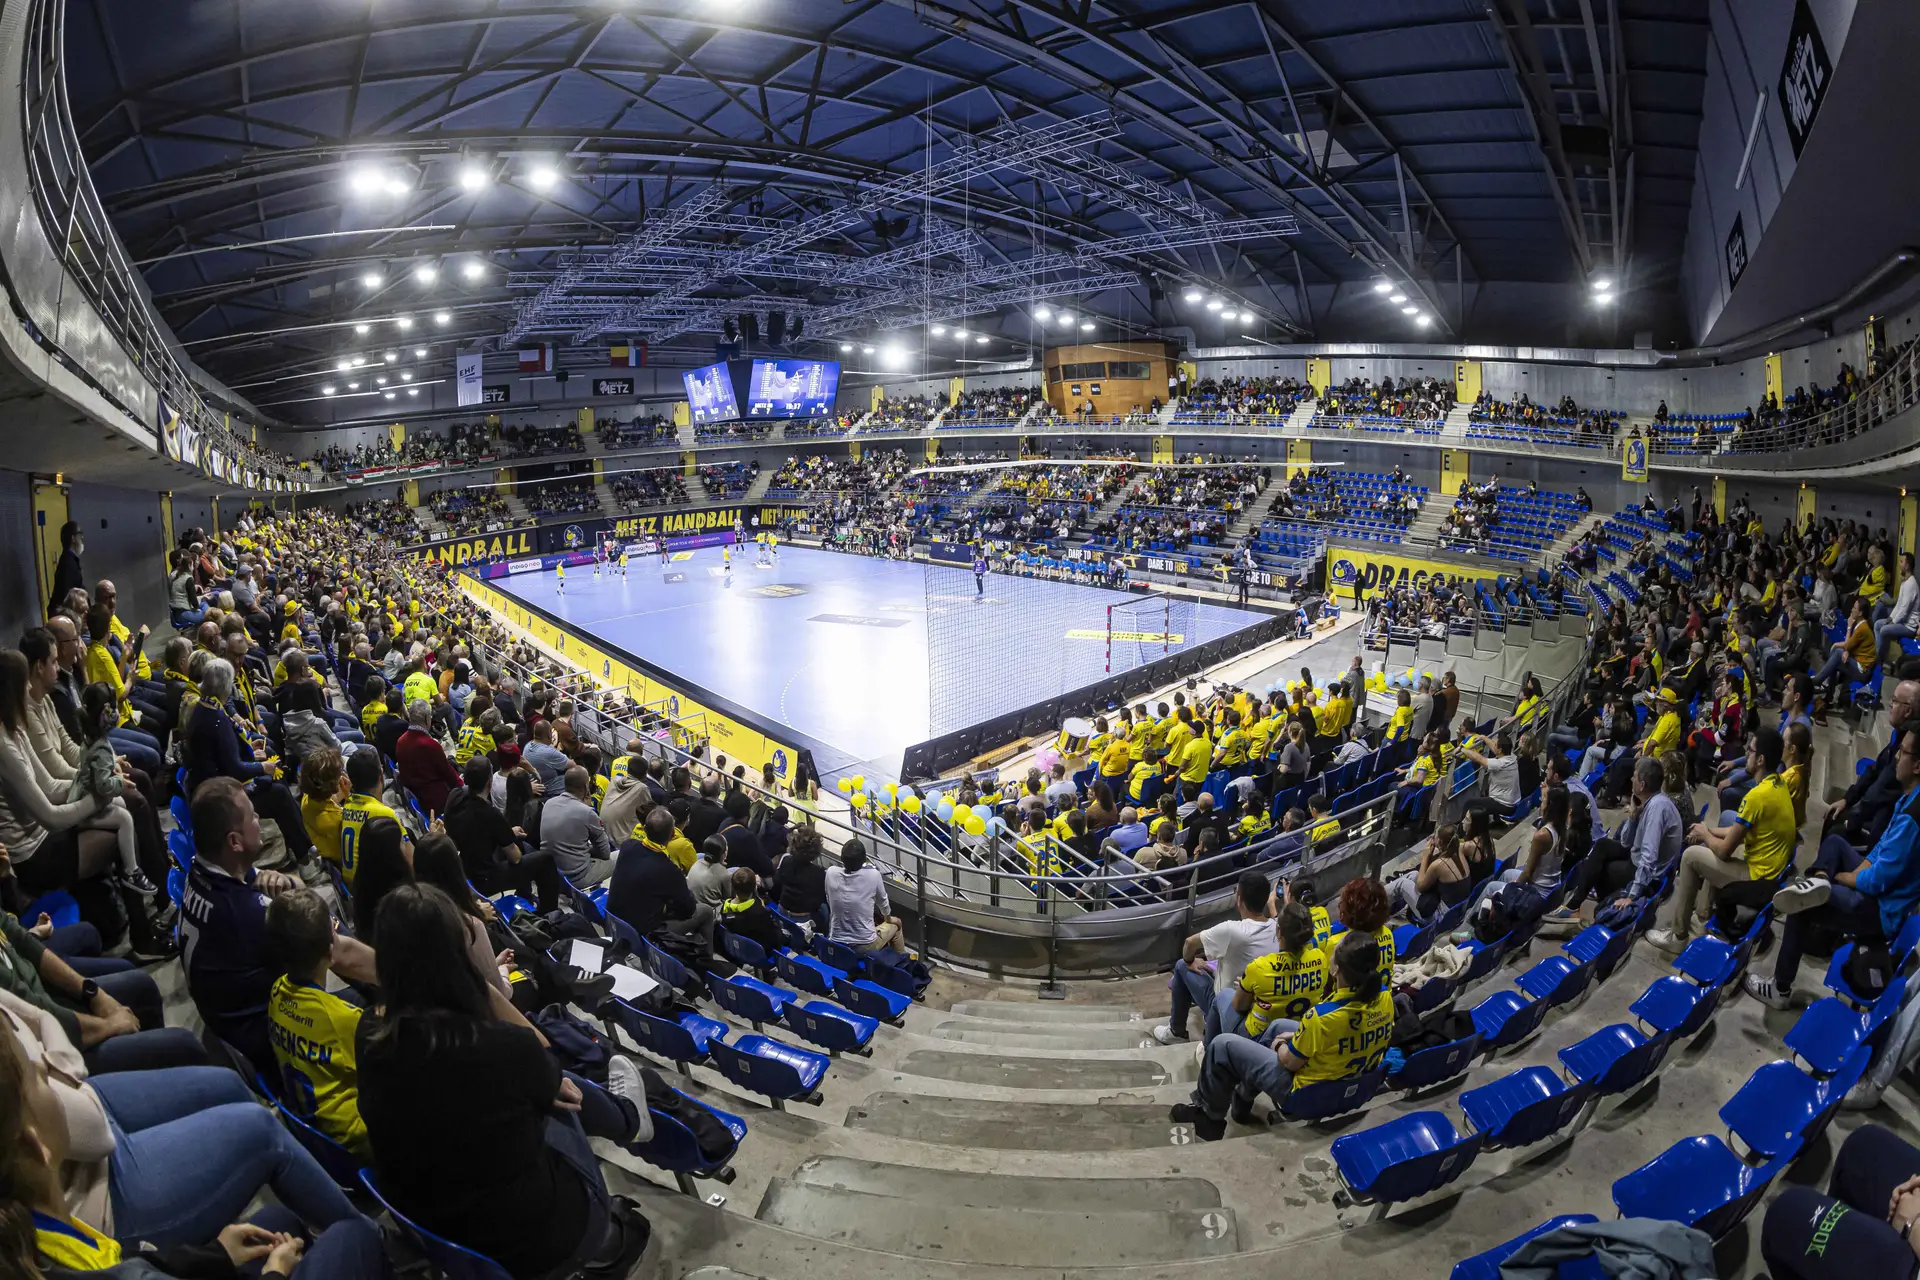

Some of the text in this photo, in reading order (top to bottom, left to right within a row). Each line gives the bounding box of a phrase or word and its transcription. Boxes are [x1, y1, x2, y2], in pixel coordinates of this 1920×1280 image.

[1788, 33, 1824, 136] METZ
[460, 365, 476, 377] EHF
[1309, 364, 1314, 377] F
[1458, 366, 1464, 381] E
[483, 391, 505, 402] ETZ
[602, 384, 629, 394] METZ
[1154, 440, 1160, 453] G
[1289, 444, 1294, 459] F
[1444, 454, 1450, 471] E
[615, 517, 657, 537] METZ
[1068, 549, 1083, 560] DARE
[1083, 550, 1091, 560] TO
[1147, 558, 1188, 573] DARE TO RISE
[1261, 573, 1270, 585] TO
[1272, 575, 1288, 588] RISE
[460, 729, 474, 748] 27
[1281, 957, 1322, 972] Althuna
[1274, 970, 1322, 996] FLIPPES
[278, 1003, 314, 1028] Cockerill
[1151, 1075, 1167, 1086] 7
[1170, 1126, 1190, 1145] 8
[1201, 1213, 1228, 1240] 9
